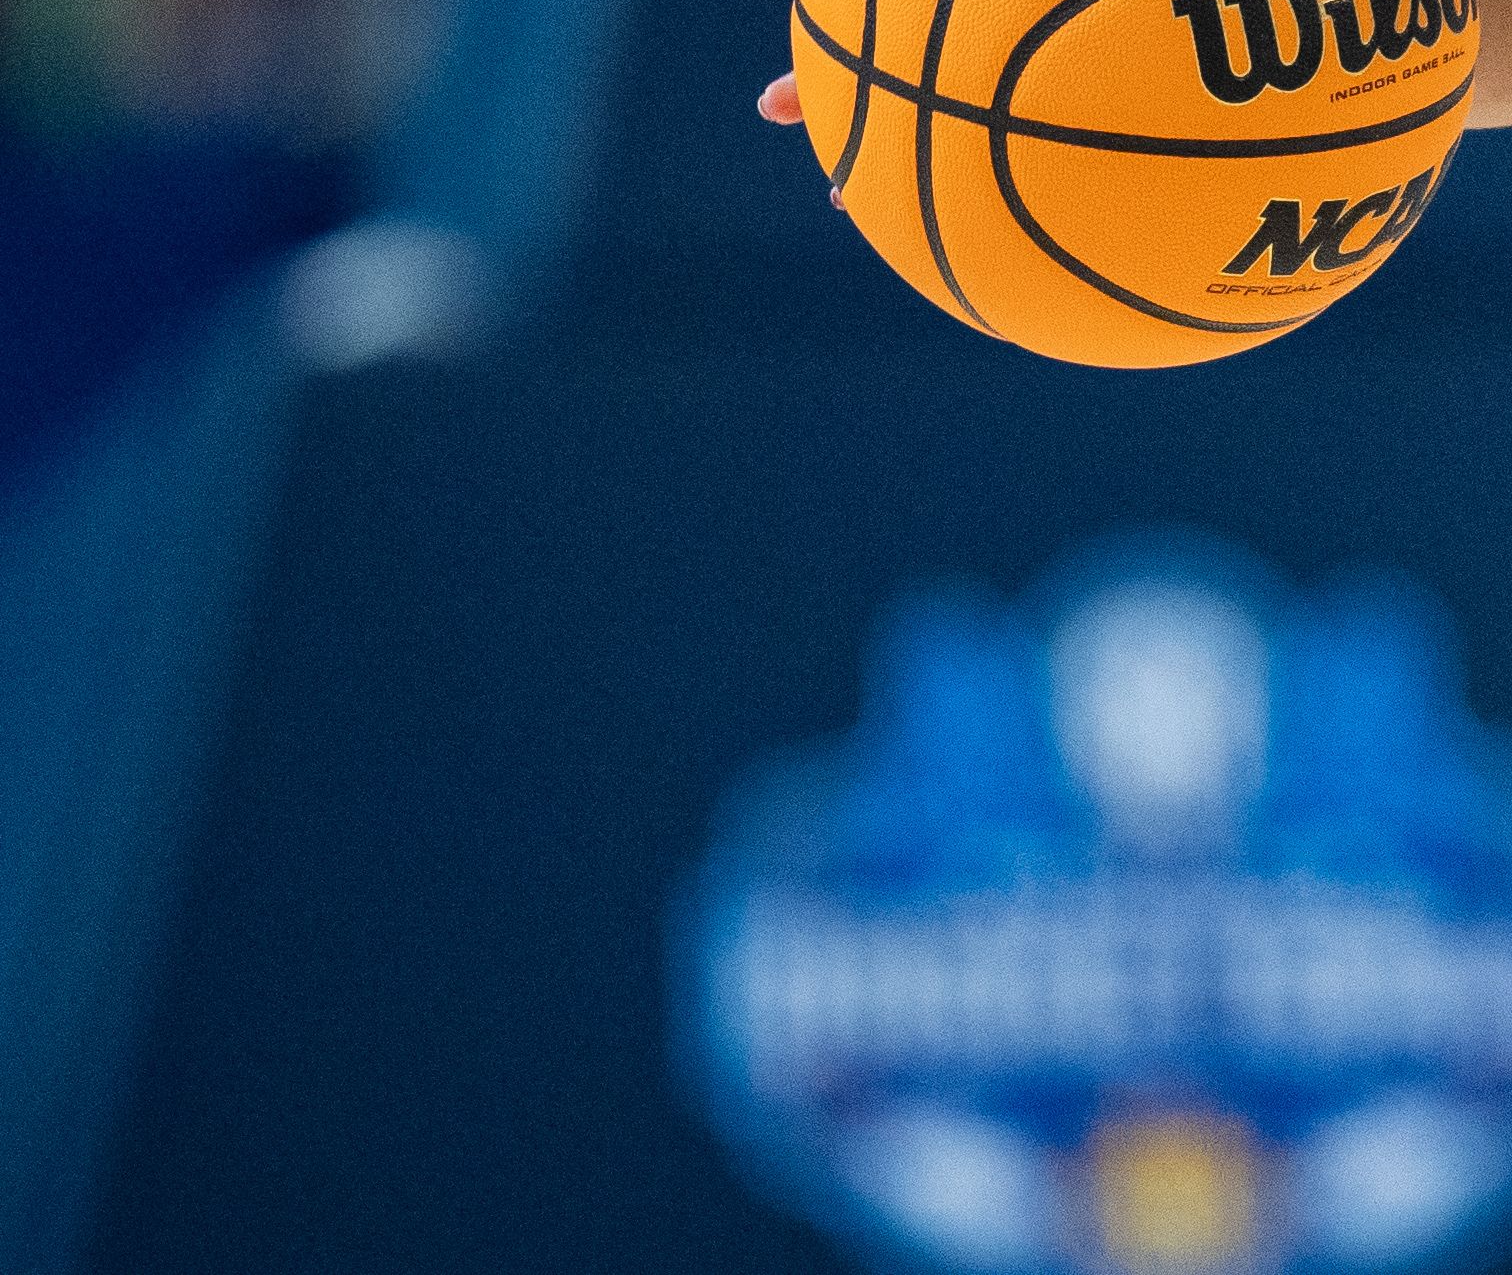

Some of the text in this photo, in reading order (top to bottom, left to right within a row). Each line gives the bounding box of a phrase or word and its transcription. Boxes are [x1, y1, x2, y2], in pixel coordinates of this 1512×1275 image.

[1329, 46, 1466, 103] INDOOR GAME BALL
[1206, 282, 1322, 297] OFFICIAL
